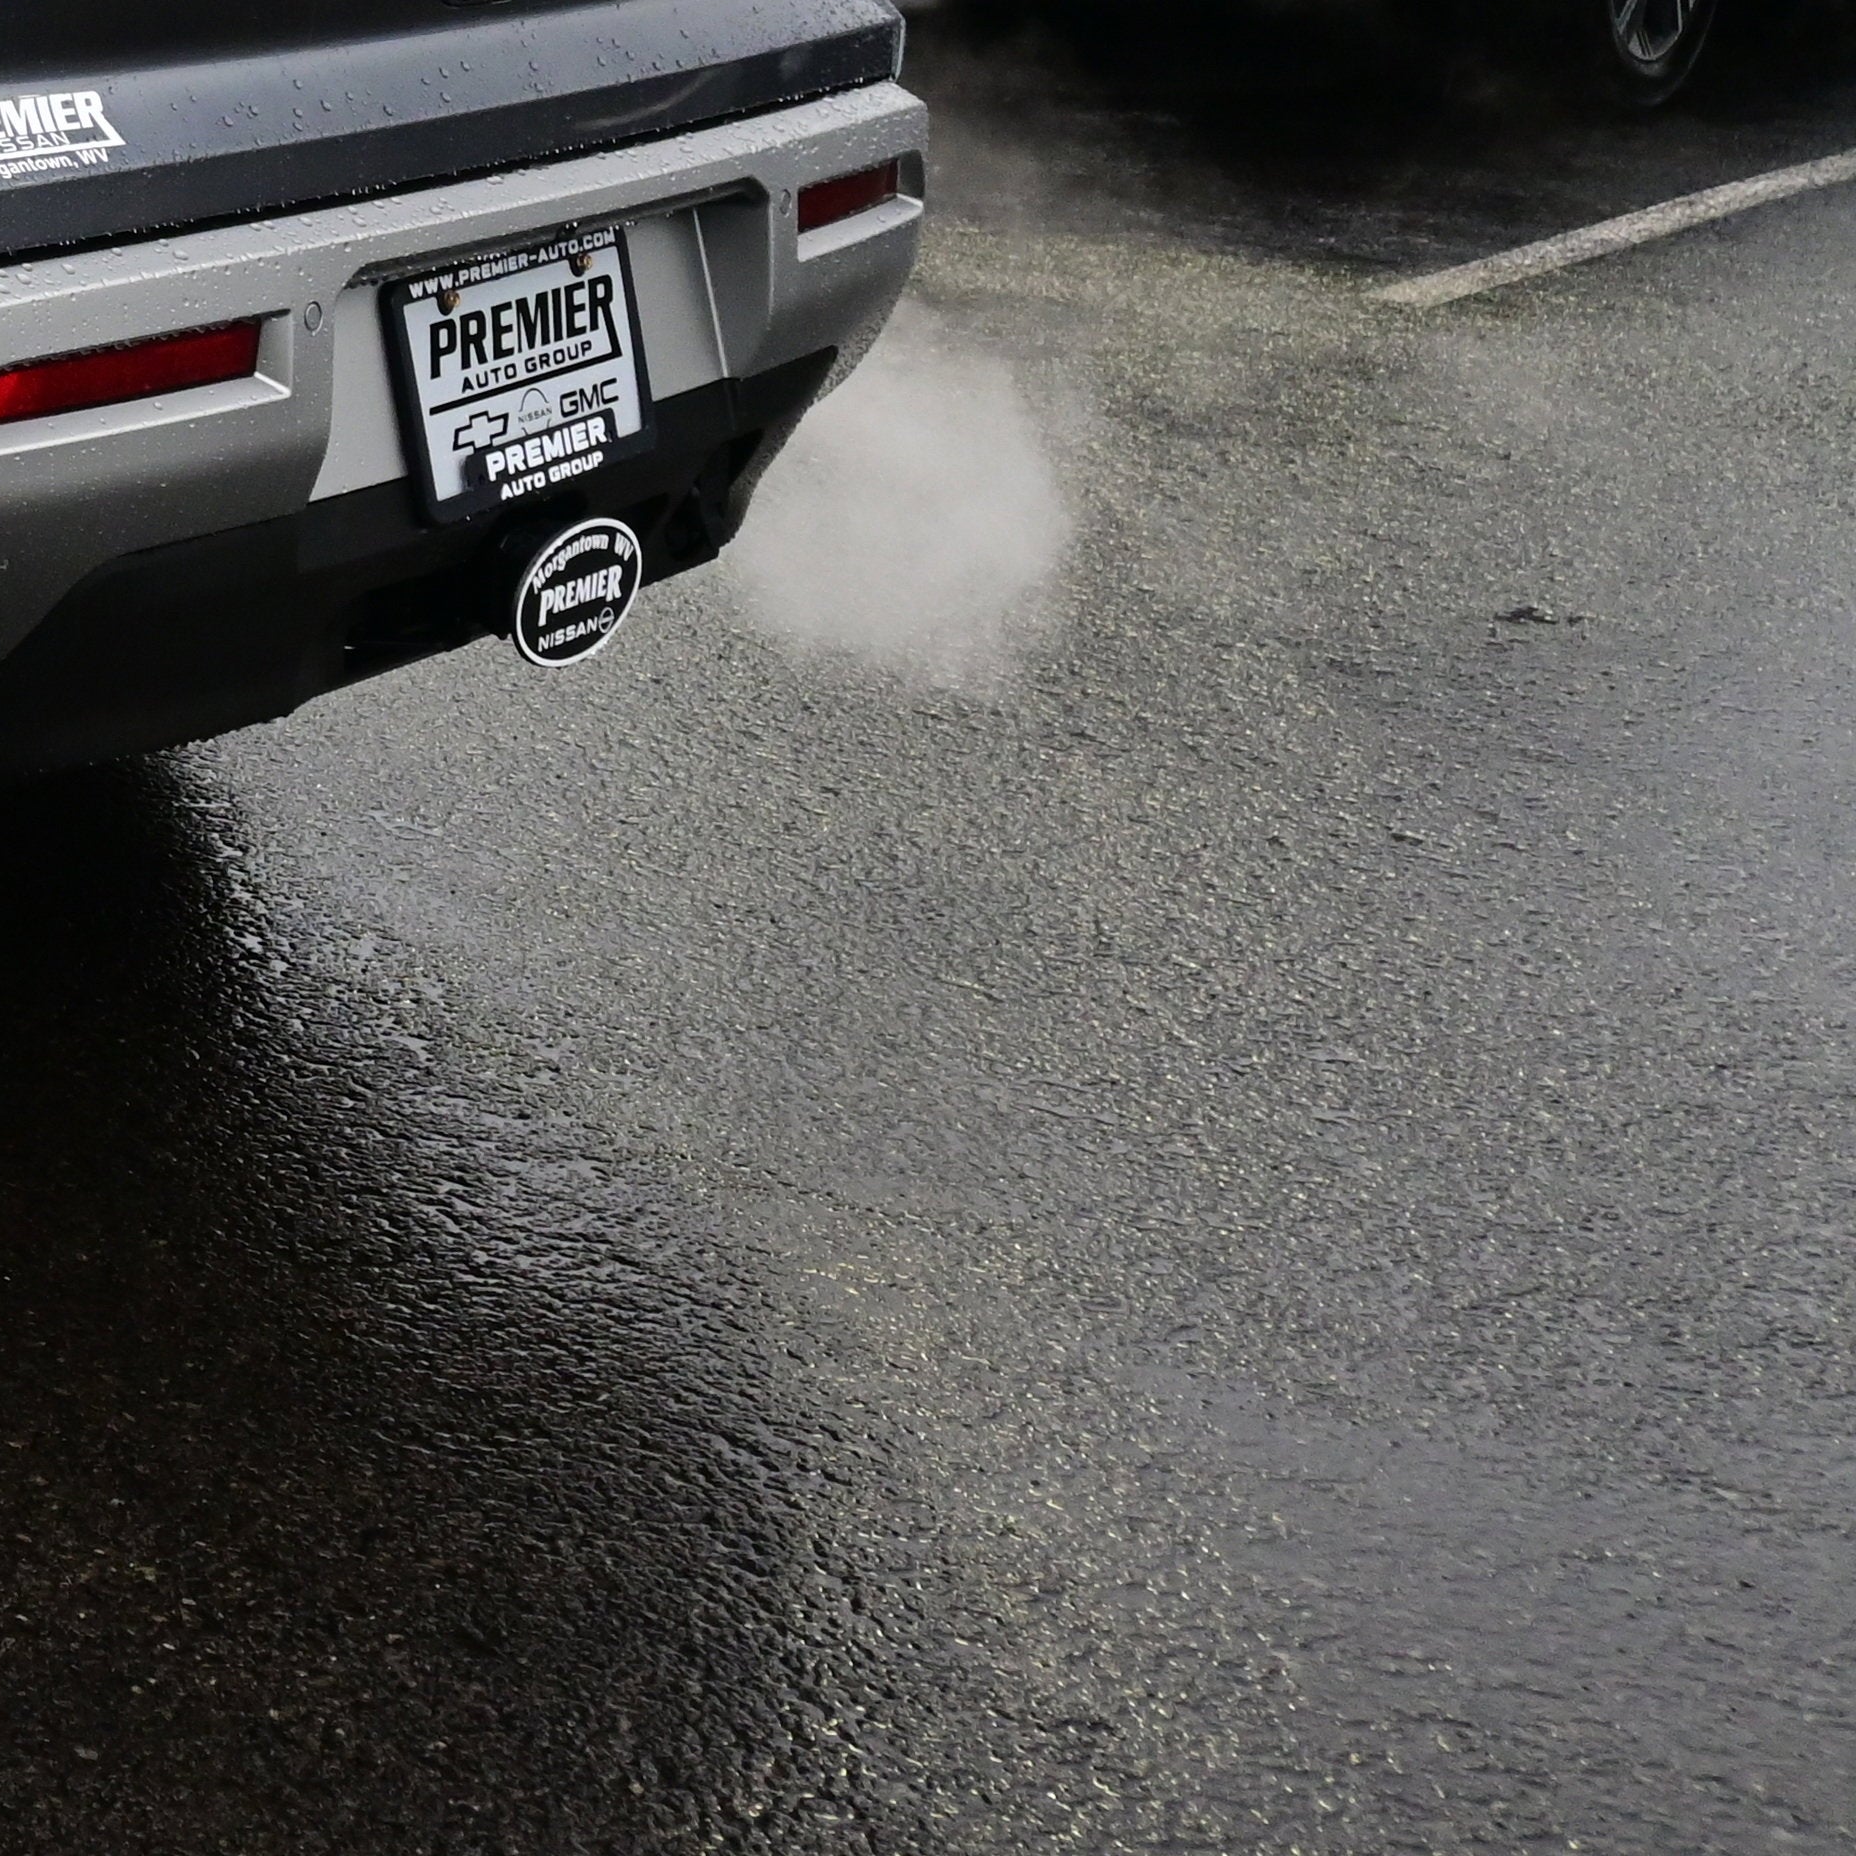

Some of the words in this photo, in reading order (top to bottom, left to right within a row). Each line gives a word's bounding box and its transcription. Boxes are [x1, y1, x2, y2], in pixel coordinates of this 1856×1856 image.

[76, 148, 109, 165] WV
[409, 227, 616, 299] WWW.PREMIER-AUTO.COM
[430, 274, 622, 380] PREMIER
[462, 363, 517, 394] AUTO
[525, 340, 592, 374] GROUP
[518, 406, 553, 423] NISSAN
[559, 377, 619, 418] GMC
[486, 416, 607, 482] PREMIER
[500, 470, 546, 501] AUTO
[548, 450, 604, 483] GROUP
[532, 533, 609, 594] Morgantown
[614, 532, 634, 562] WV
[538, 564, 623, 627] PREMIER
[538, 616, 598, 652] NISSAN
